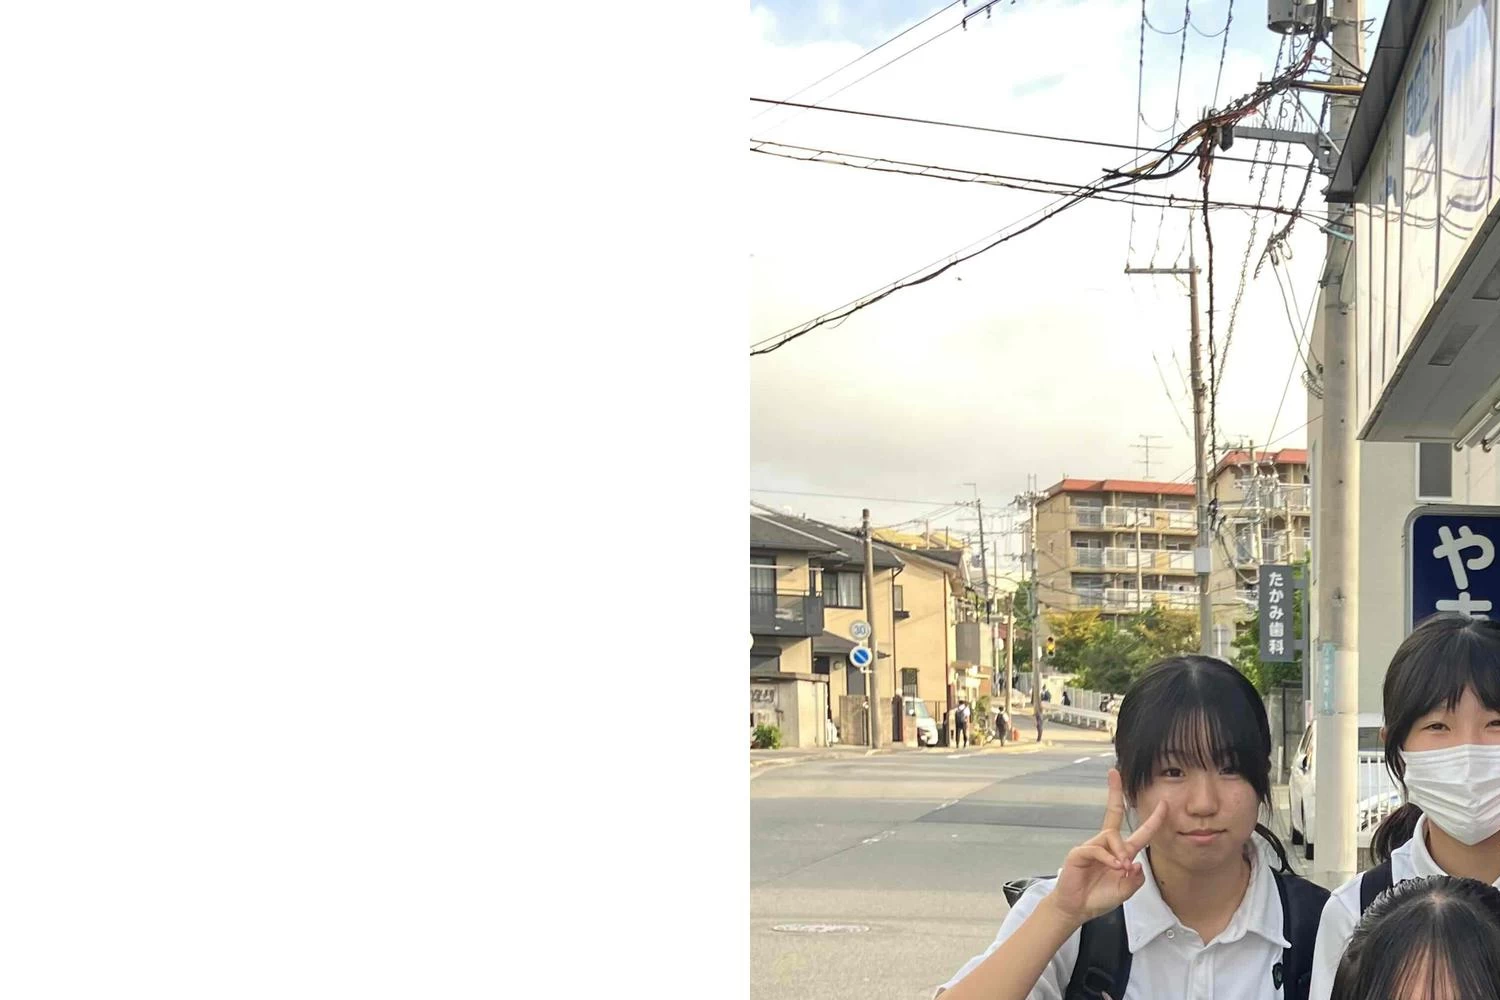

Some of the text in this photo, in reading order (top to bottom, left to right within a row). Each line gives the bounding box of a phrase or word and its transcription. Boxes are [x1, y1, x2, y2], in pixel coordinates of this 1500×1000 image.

[1268, 571, 1284, 655] たかみ歯科
